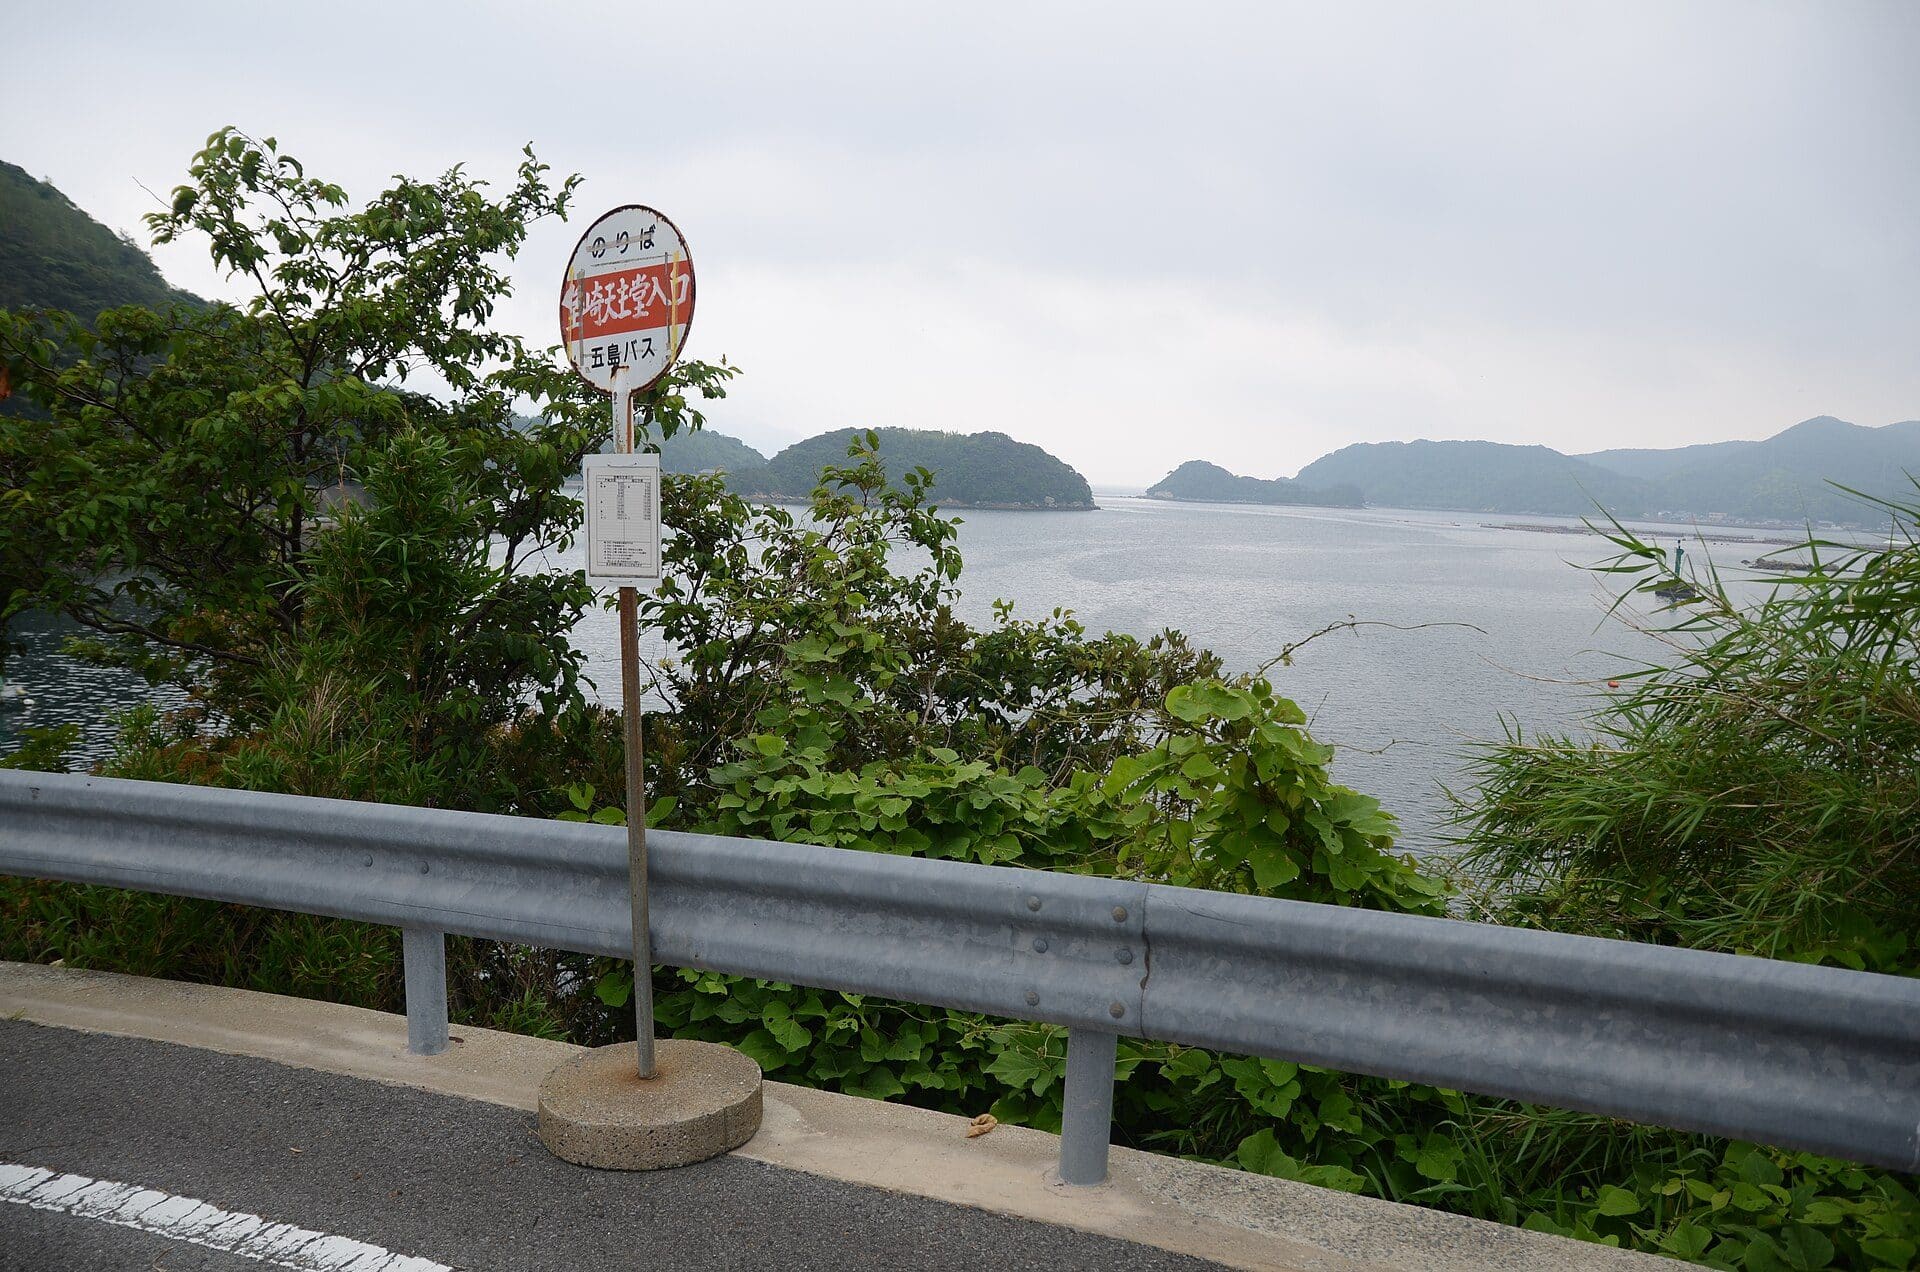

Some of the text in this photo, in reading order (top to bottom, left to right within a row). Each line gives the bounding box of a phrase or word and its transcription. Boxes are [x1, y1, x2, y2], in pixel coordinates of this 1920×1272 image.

[592, 224, 656, 258] のりば
[591, 338, 655, 368] 五島バス
